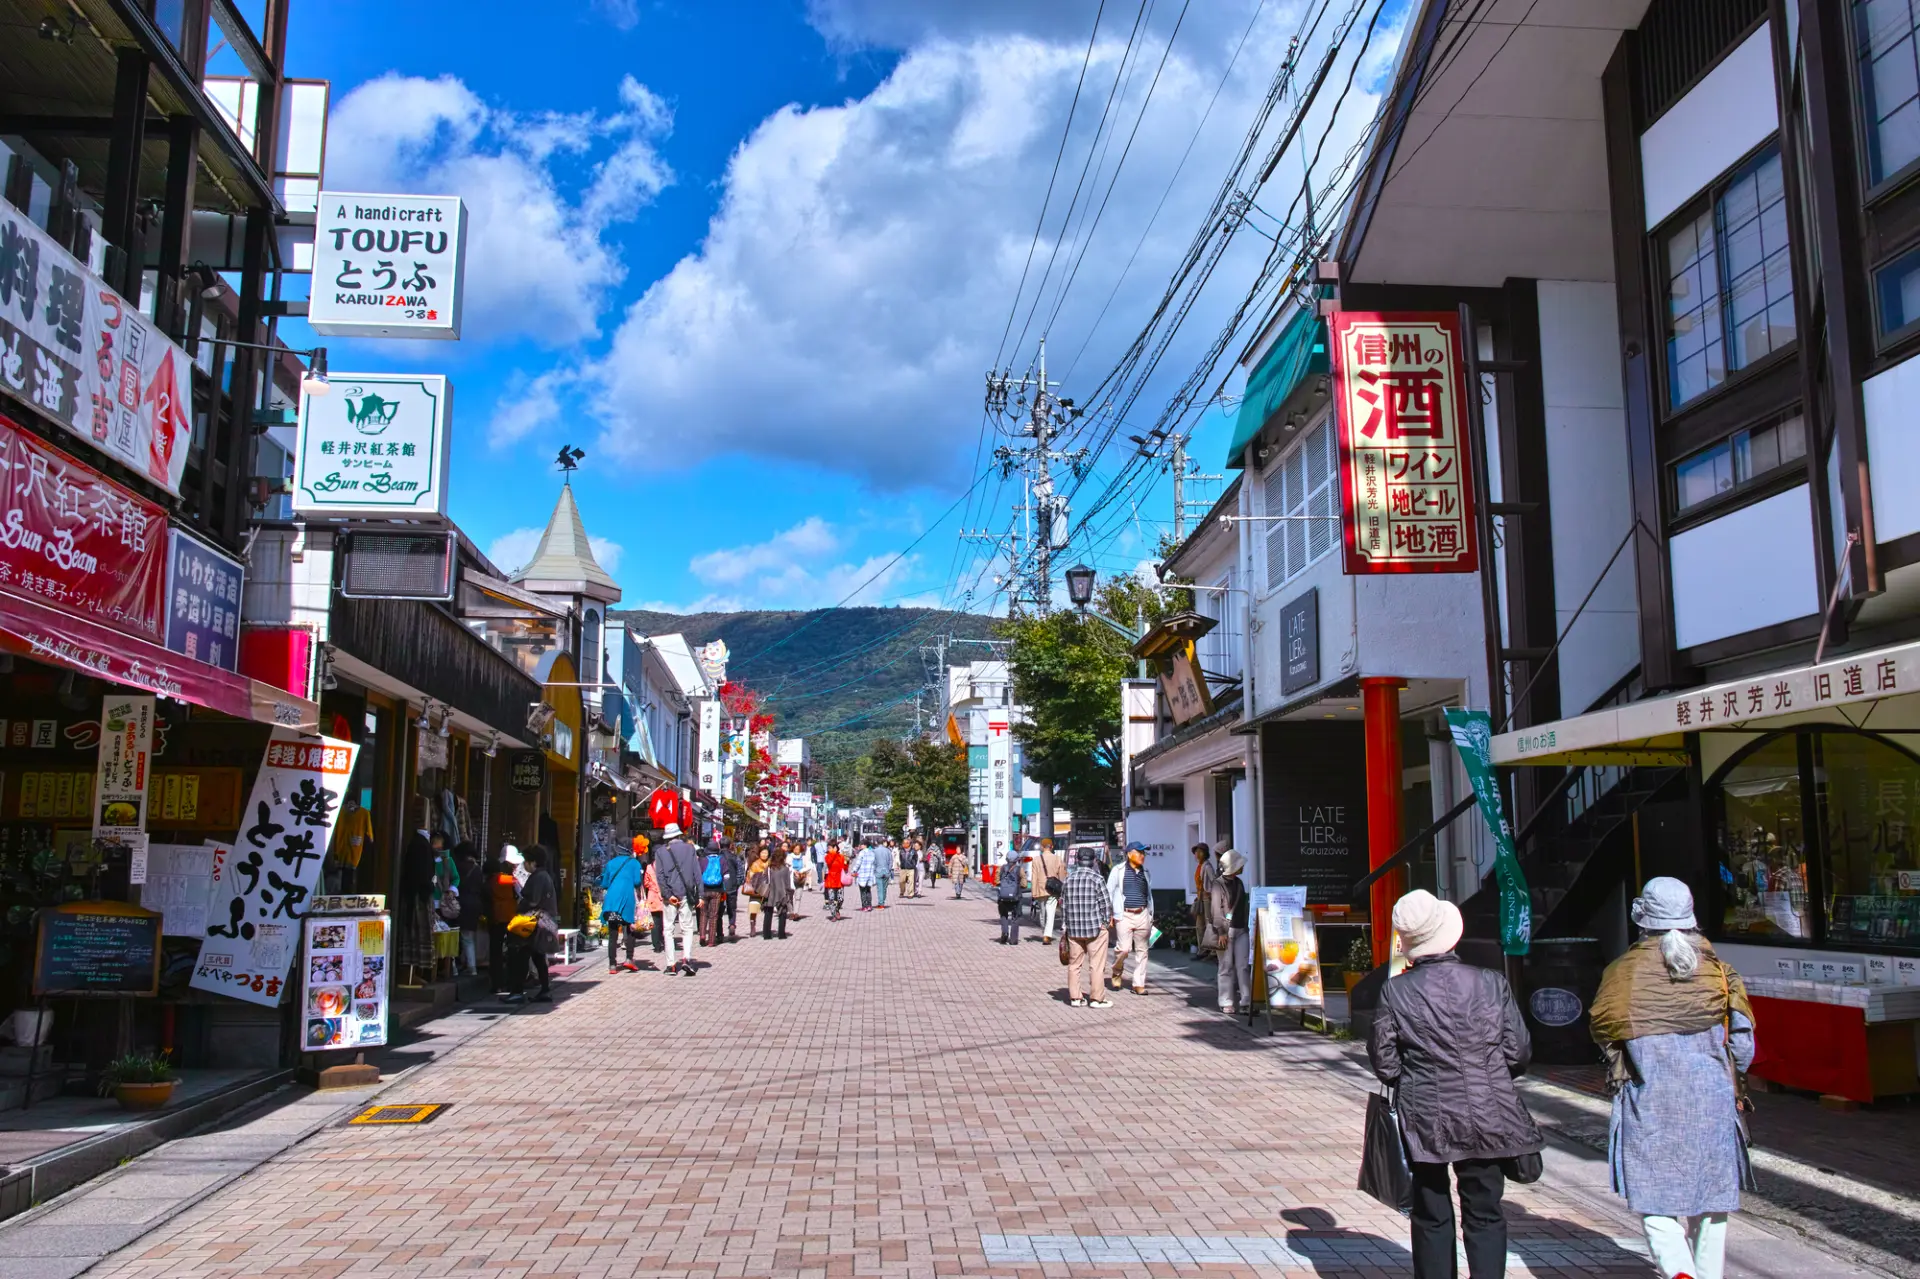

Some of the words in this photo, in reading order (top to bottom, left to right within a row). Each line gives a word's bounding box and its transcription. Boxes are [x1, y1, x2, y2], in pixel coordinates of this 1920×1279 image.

[337, 204, 347, 219] A
[355, 205, 442, 222] handicraft
[328, 227, 448, 254] TOUFU
[335, 259, 437, 292] とうふ
[335, 293, 428, 307] KARUIZAWA
[404, 309, 438, 320] つる吉
[1353, 333, 1444, 366] 信州の
[1356, 367, 1444, 439] 酒
[321, 440, 416, 457] 軽井沢紅茶館
[342, 458, 393, 469] サンビーム
[1390, 451, 1453, 480] ワイン
[313, 471, 358, 492] Sun
[363, 472, 419, 494] Beam
[1364, 453, 1379, 511] 軽井沢芳光
[1391, 488, 1456, 517] 地ビール
[0, 508, 42, 553] Sun
[45, 525, 98, 575] Beam
[1368, 516, 1380, 550] 旧道店
[1395, 523, 1459, 553] 地酒
[1676, 681, 1792, 726] 軽井沢芳光
[1813, 658, 1897, 701] 旧道店
[1517, 730, 1556, 753] 信州のお酒
[268, 744, 348, 770] 手造り限定品
[994, 770, 1004, 799] 郵便局
[1299, 806, 1345, 824] L'ATE
[996, 840, 1003, 849] P
[1299, 826, 1336, 844] LIER
[1300, 845, 1349, 856] Karuizawa
[1507, 890, 1516, 922] SINCE
[234, 973, 283, 997] つる吉
